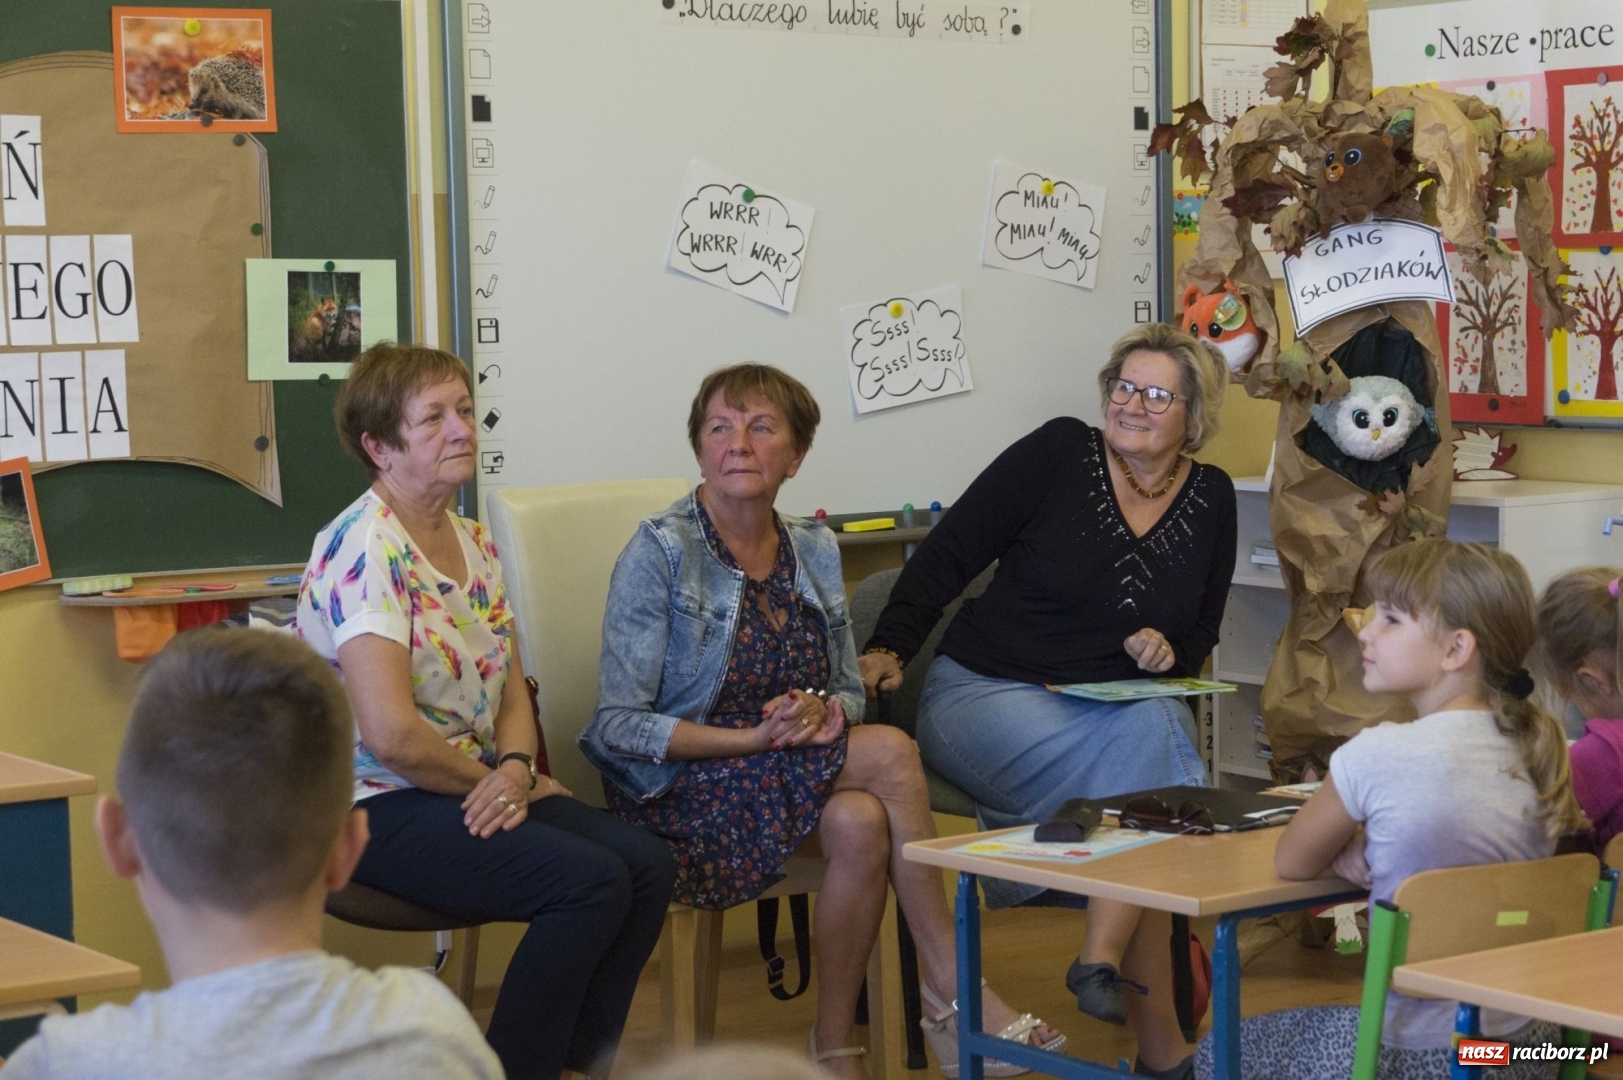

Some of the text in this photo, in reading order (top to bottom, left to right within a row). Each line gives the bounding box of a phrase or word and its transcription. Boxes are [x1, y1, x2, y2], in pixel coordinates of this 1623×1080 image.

[828, 0, 879, 29] lubię
[896, 0, 926, 37] być
[943, 5, 988, 36] sobą
[1437, 23, 1615, 63] Nasze prace
[709, 201, 771, 234] WRRR!
[690, 232, 795, 281] WRRR! WRR!
[1315, 229, 1383, 257] GANG
[0, 260, 133, 320] EGO
[1301, 250, 1444, 305] SŁODZIAKÓW
